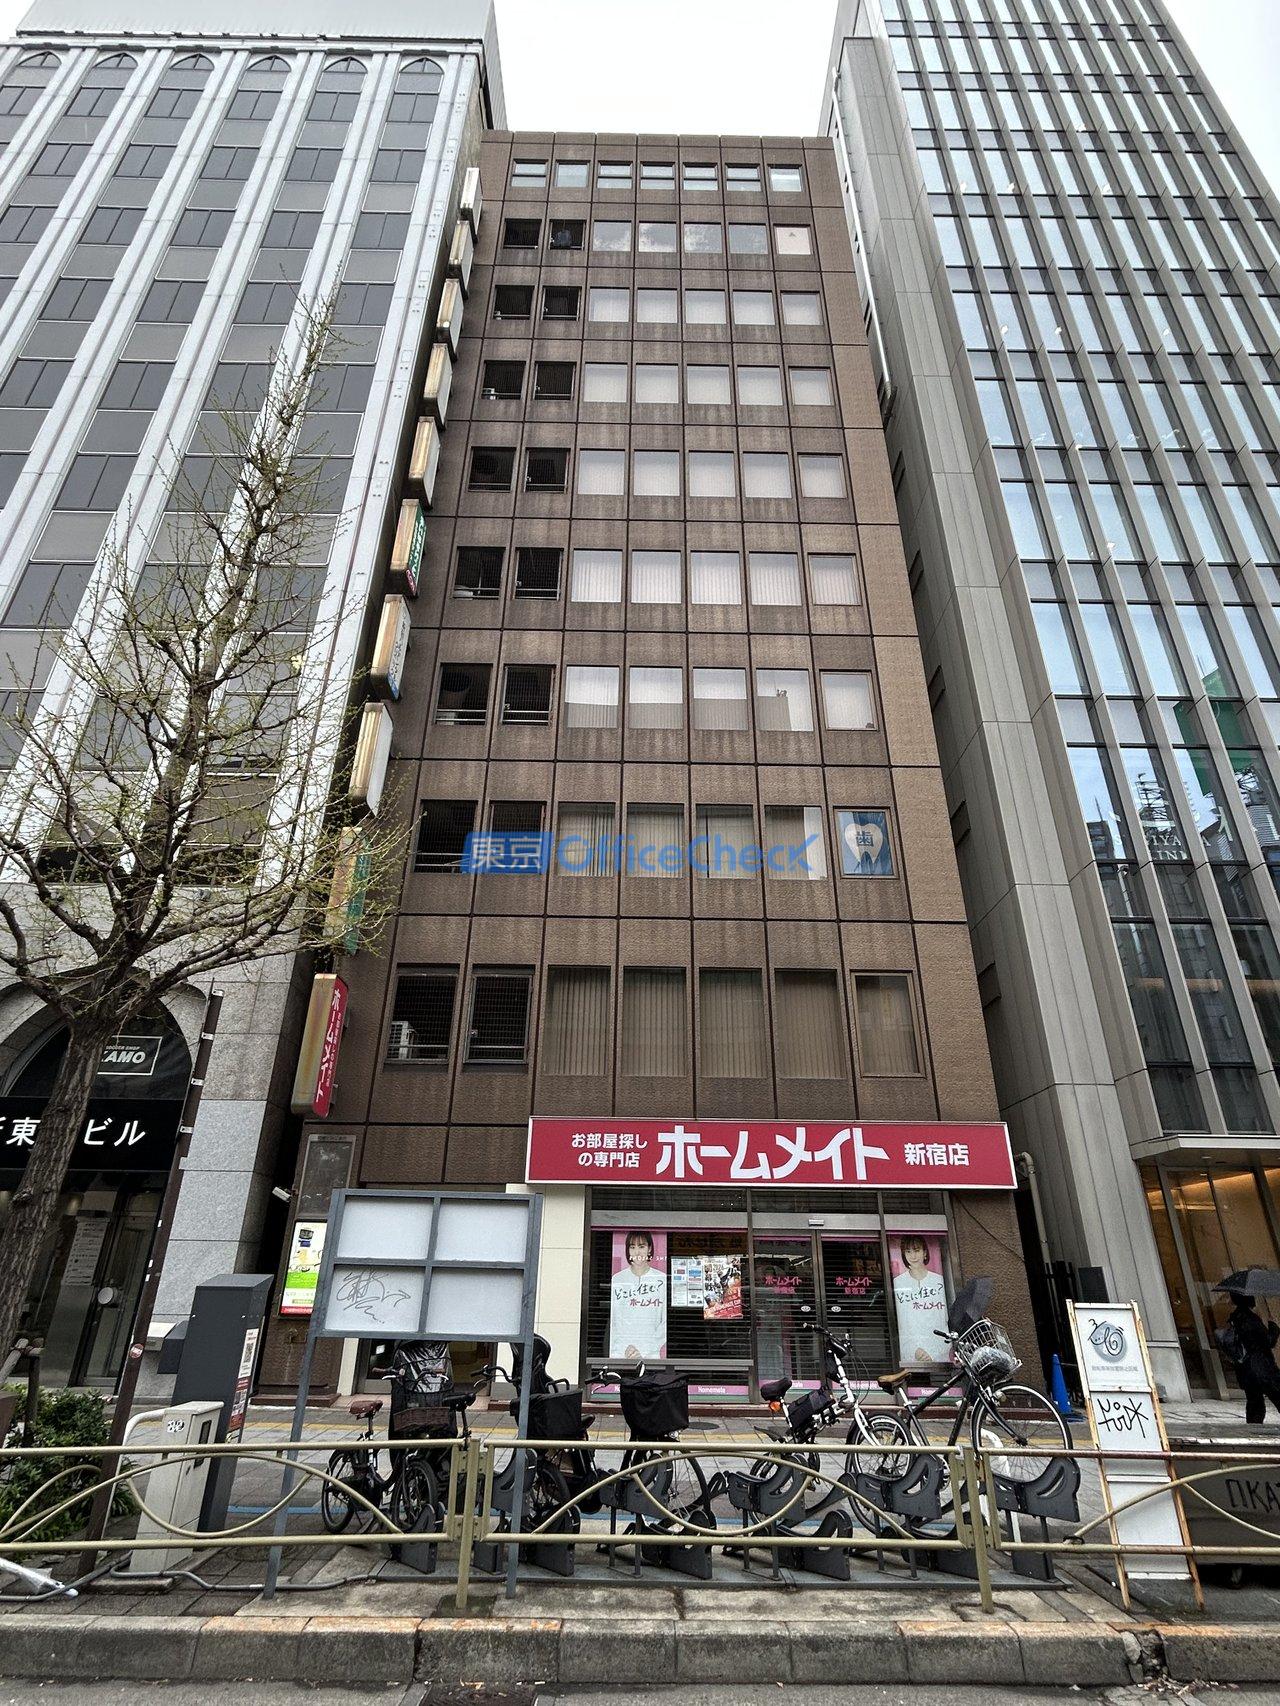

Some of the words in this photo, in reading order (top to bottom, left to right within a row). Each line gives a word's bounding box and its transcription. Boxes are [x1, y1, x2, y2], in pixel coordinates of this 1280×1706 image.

[856, 830, 874, 847] 歯
[316, 988, 341, 1102] ホームメイト
[101, 1050, 146, 1064] AMO
[571, 1133, 648, 1149] お部屋探し
[577, 1151, 640, 1168] の専門店
[656, 1125, 891, 1181] ホームメイト
[903, 1142, 970, 1166] 新宿店
[765, 1275, 802, 1286] ホームメイト
[835, 1276, 873, 1287] ホームメイト
[629, 1298, 663, 1307] ホームメイト
[912, 1301, 946, 1310] ホームメイト
